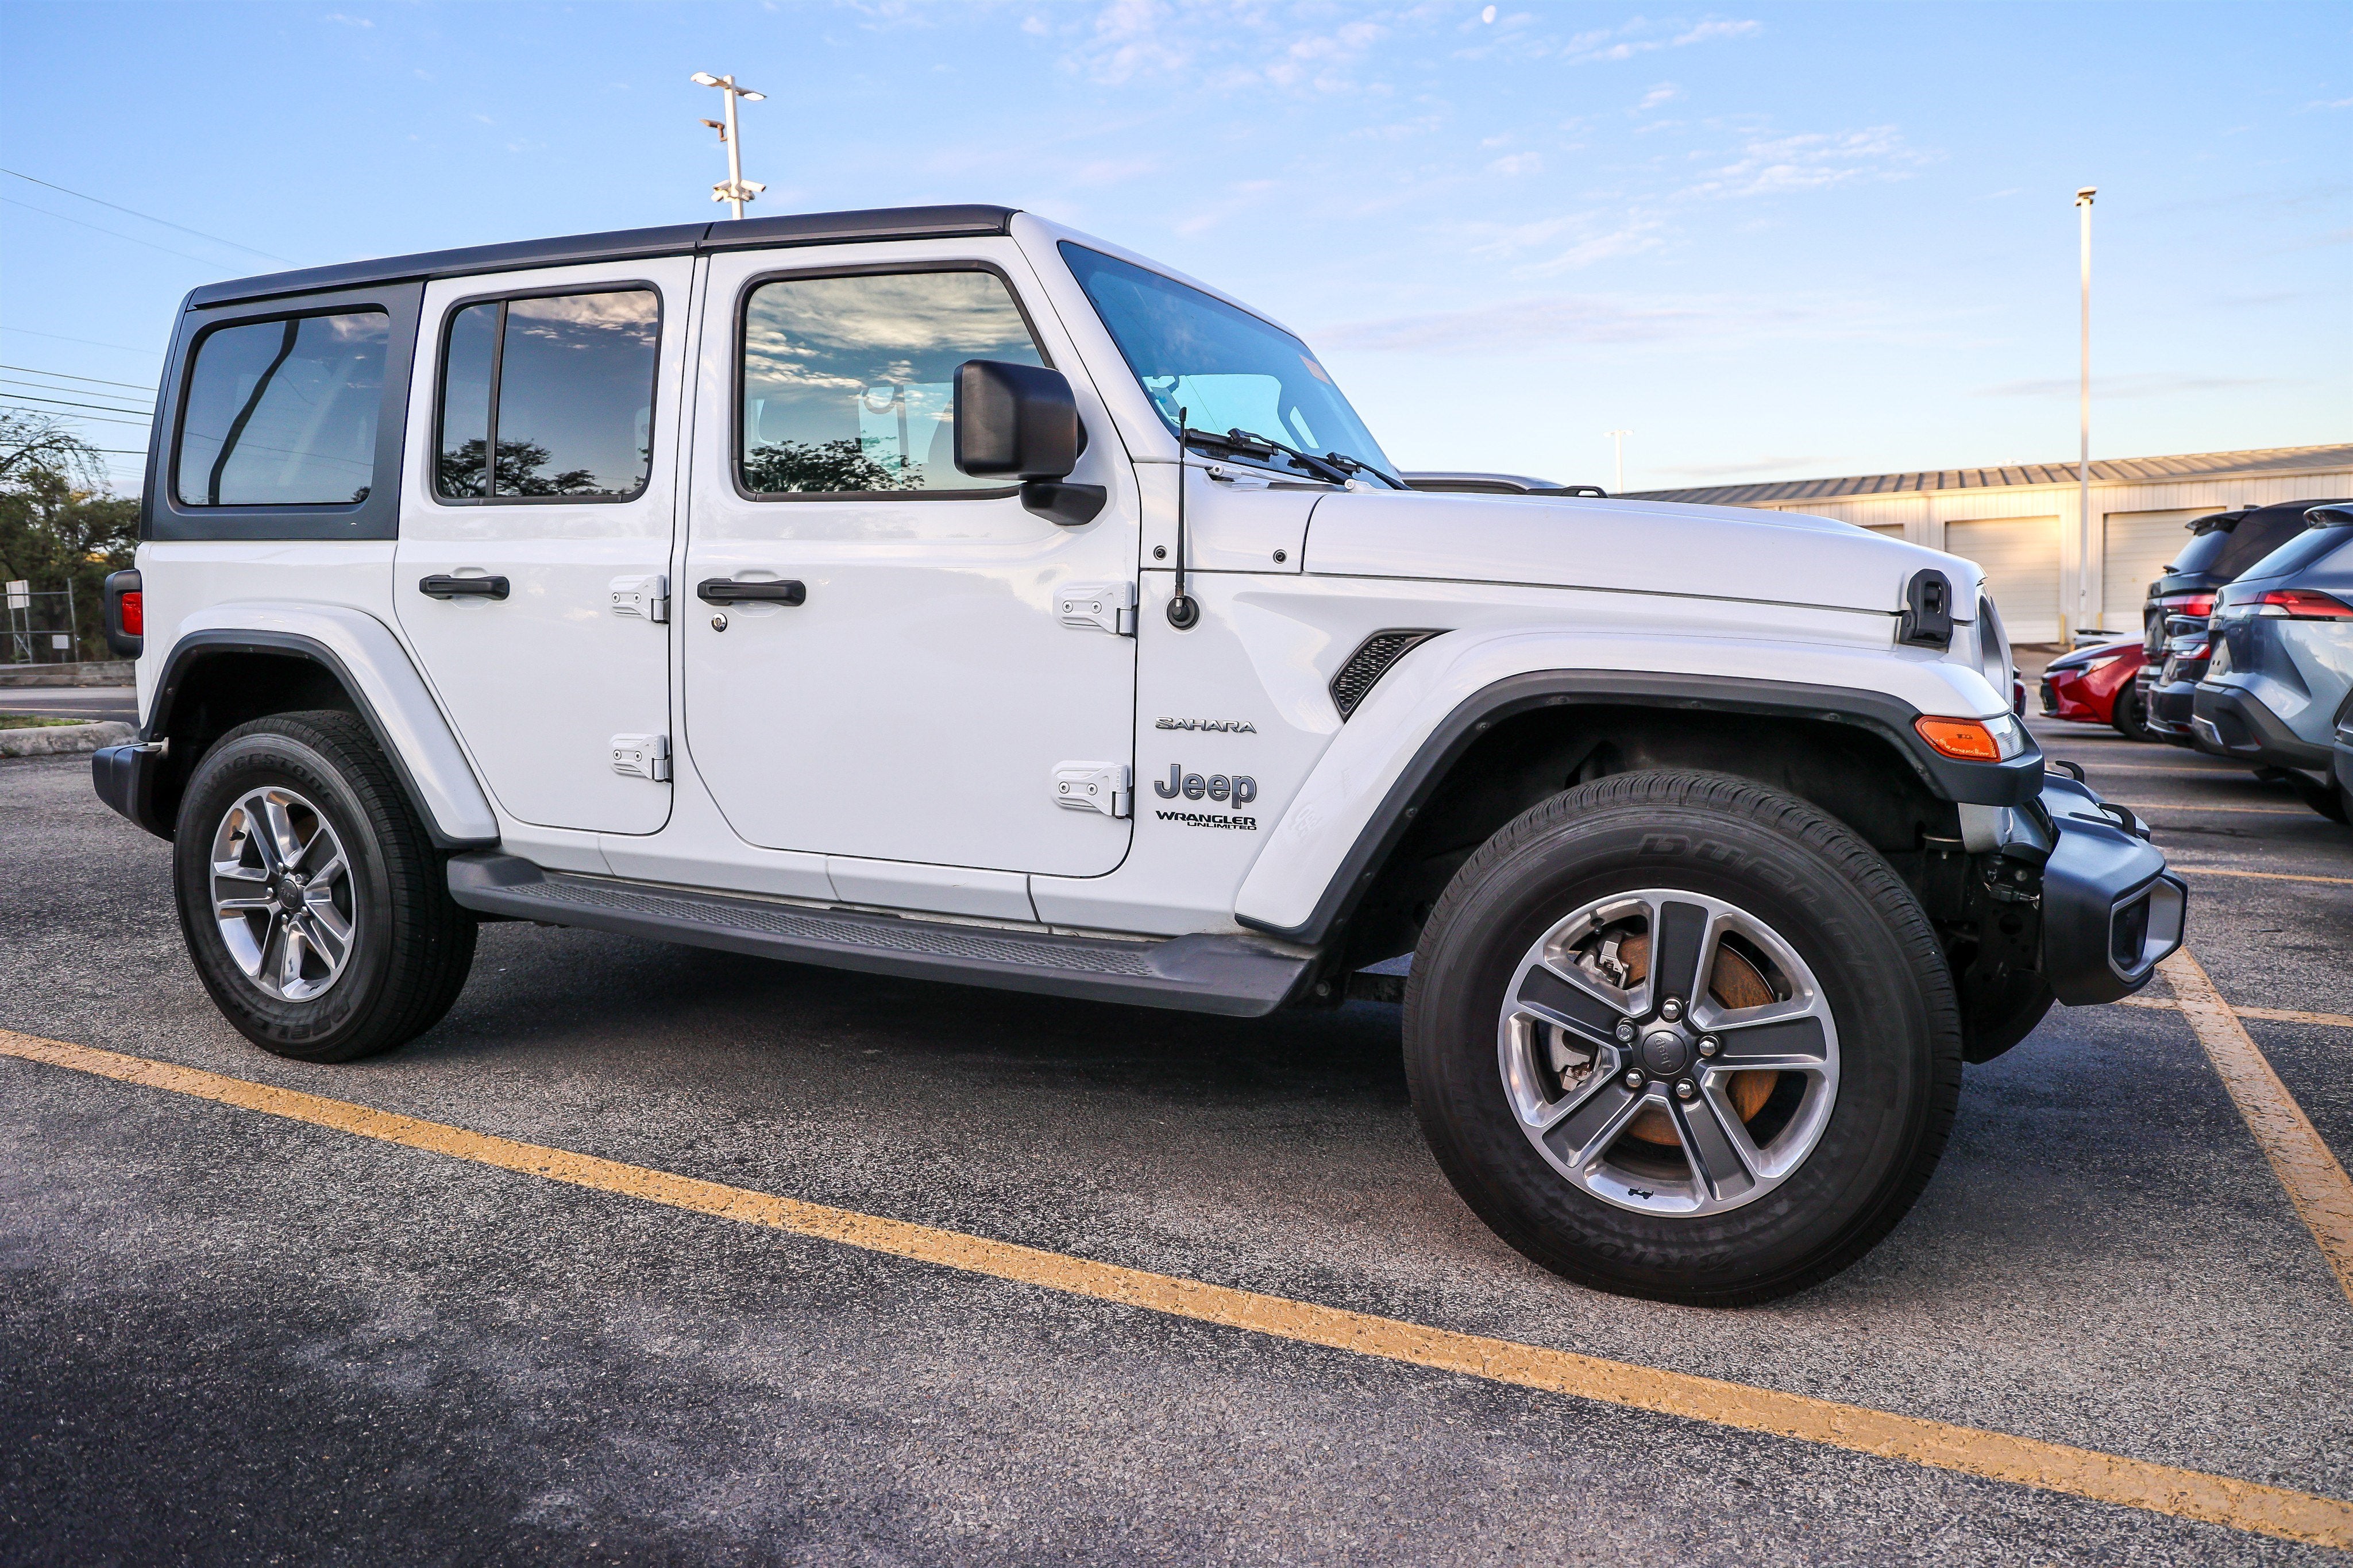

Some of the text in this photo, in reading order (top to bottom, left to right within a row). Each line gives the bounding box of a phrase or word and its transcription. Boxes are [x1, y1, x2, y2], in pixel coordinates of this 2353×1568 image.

[1155, 716, 1257, 733] SAHARA
[1154, 763, 1257, 809] Jeep
[1155, 810, 1256, 826] WRANGLER
[1187, 822, 1257, 831] UNLIMITED
